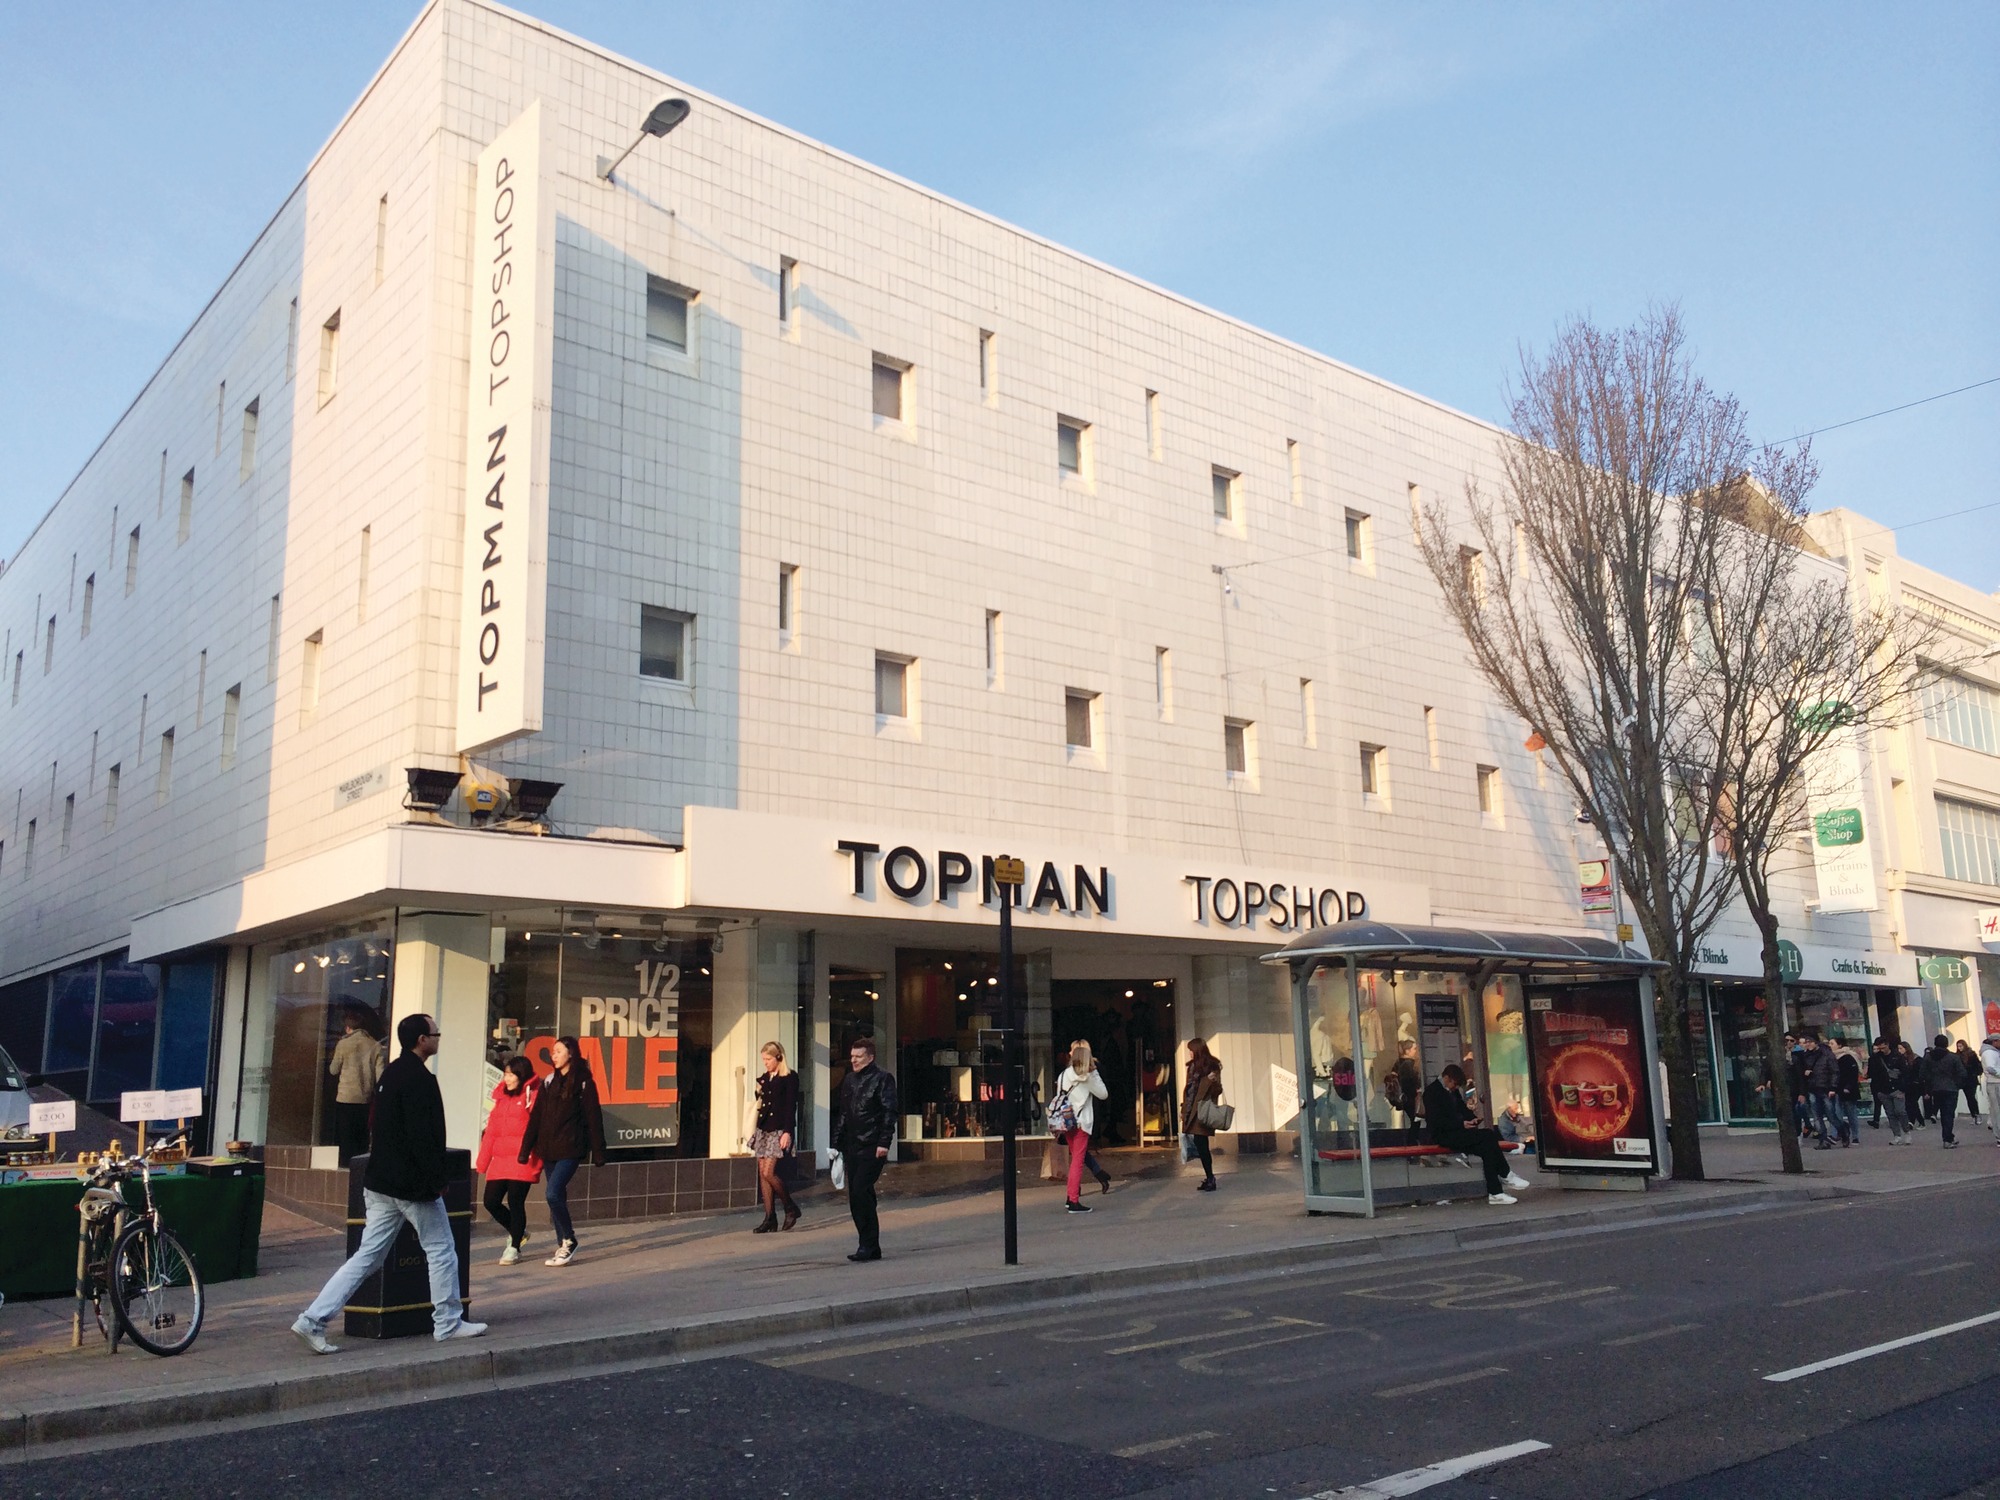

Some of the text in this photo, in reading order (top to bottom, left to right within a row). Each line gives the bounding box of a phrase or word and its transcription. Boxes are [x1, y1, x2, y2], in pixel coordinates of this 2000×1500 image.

[478, 157, 515, 712] TOPMAN TOPSHOP
[1822, 813, 1855, 827] Coffee
[1827, 828, 1853, 841] Shop
[1820, 861, 1868, 873] Curtains
[836, 840, 1109, 913] TOPMAN
[1839, 872, 1848, 882] &
[1829, 884, 1865, 896] Blinds
[1182, 875, 1366, 929] TOPSHOP
[1984, 915, 2000, 934] H&
[1702, 948, 1729, 965] Blinds
[1831, 959, 1886, 976] Crafts & Fashion
[1925, 962, 1963, 979] C H
[634, 959, 680, 998] 1/2
[580, 996, 679, 1038] PRICE
[617, 1127, 671, 1141] TOPMAN
